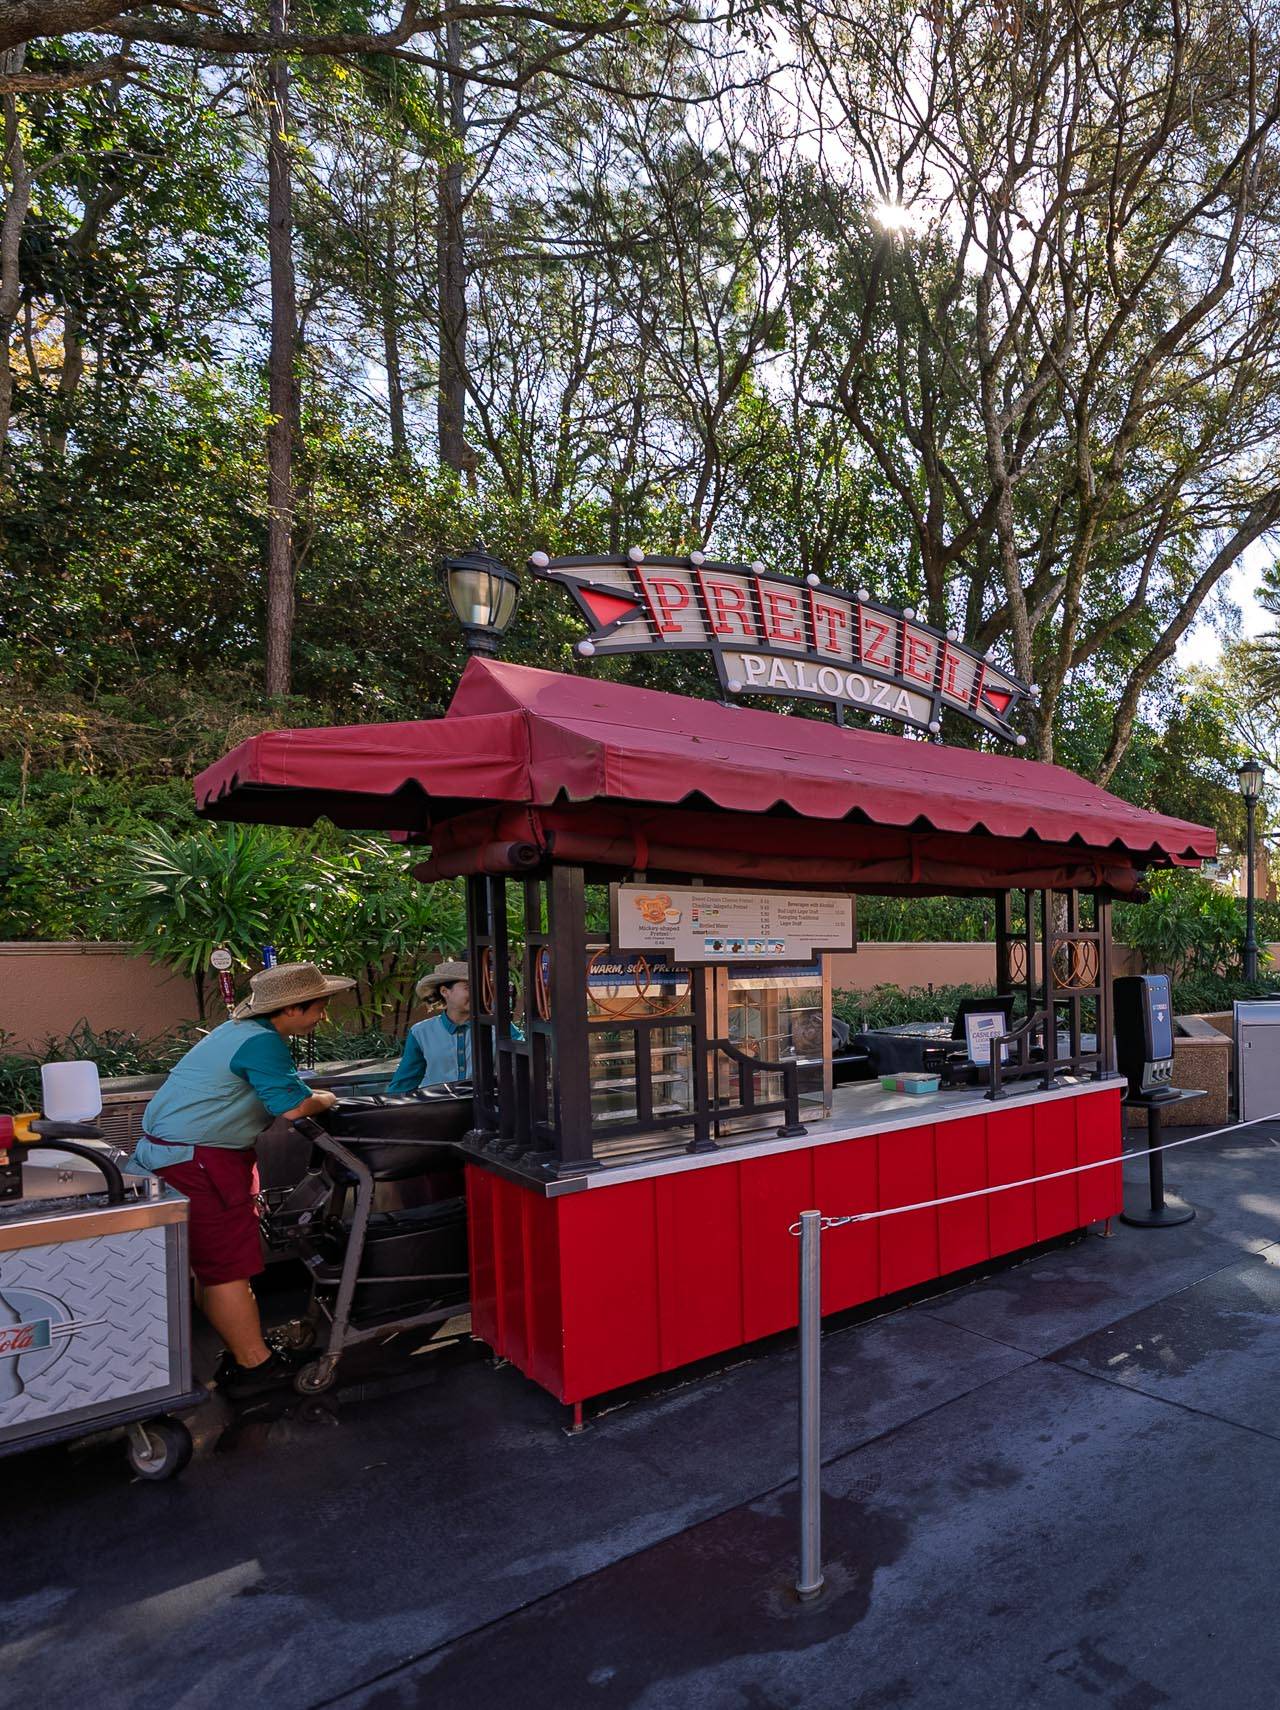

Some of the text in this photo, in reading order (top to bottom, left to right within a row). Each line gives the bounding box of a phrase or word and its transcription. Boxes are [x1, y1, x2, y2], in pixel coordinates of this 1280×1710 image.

[648, 577, 968, 703] PRETZEL
[740, 654, 916, 719] PALOOZA
[590, 964, 623, 975] WARM,
